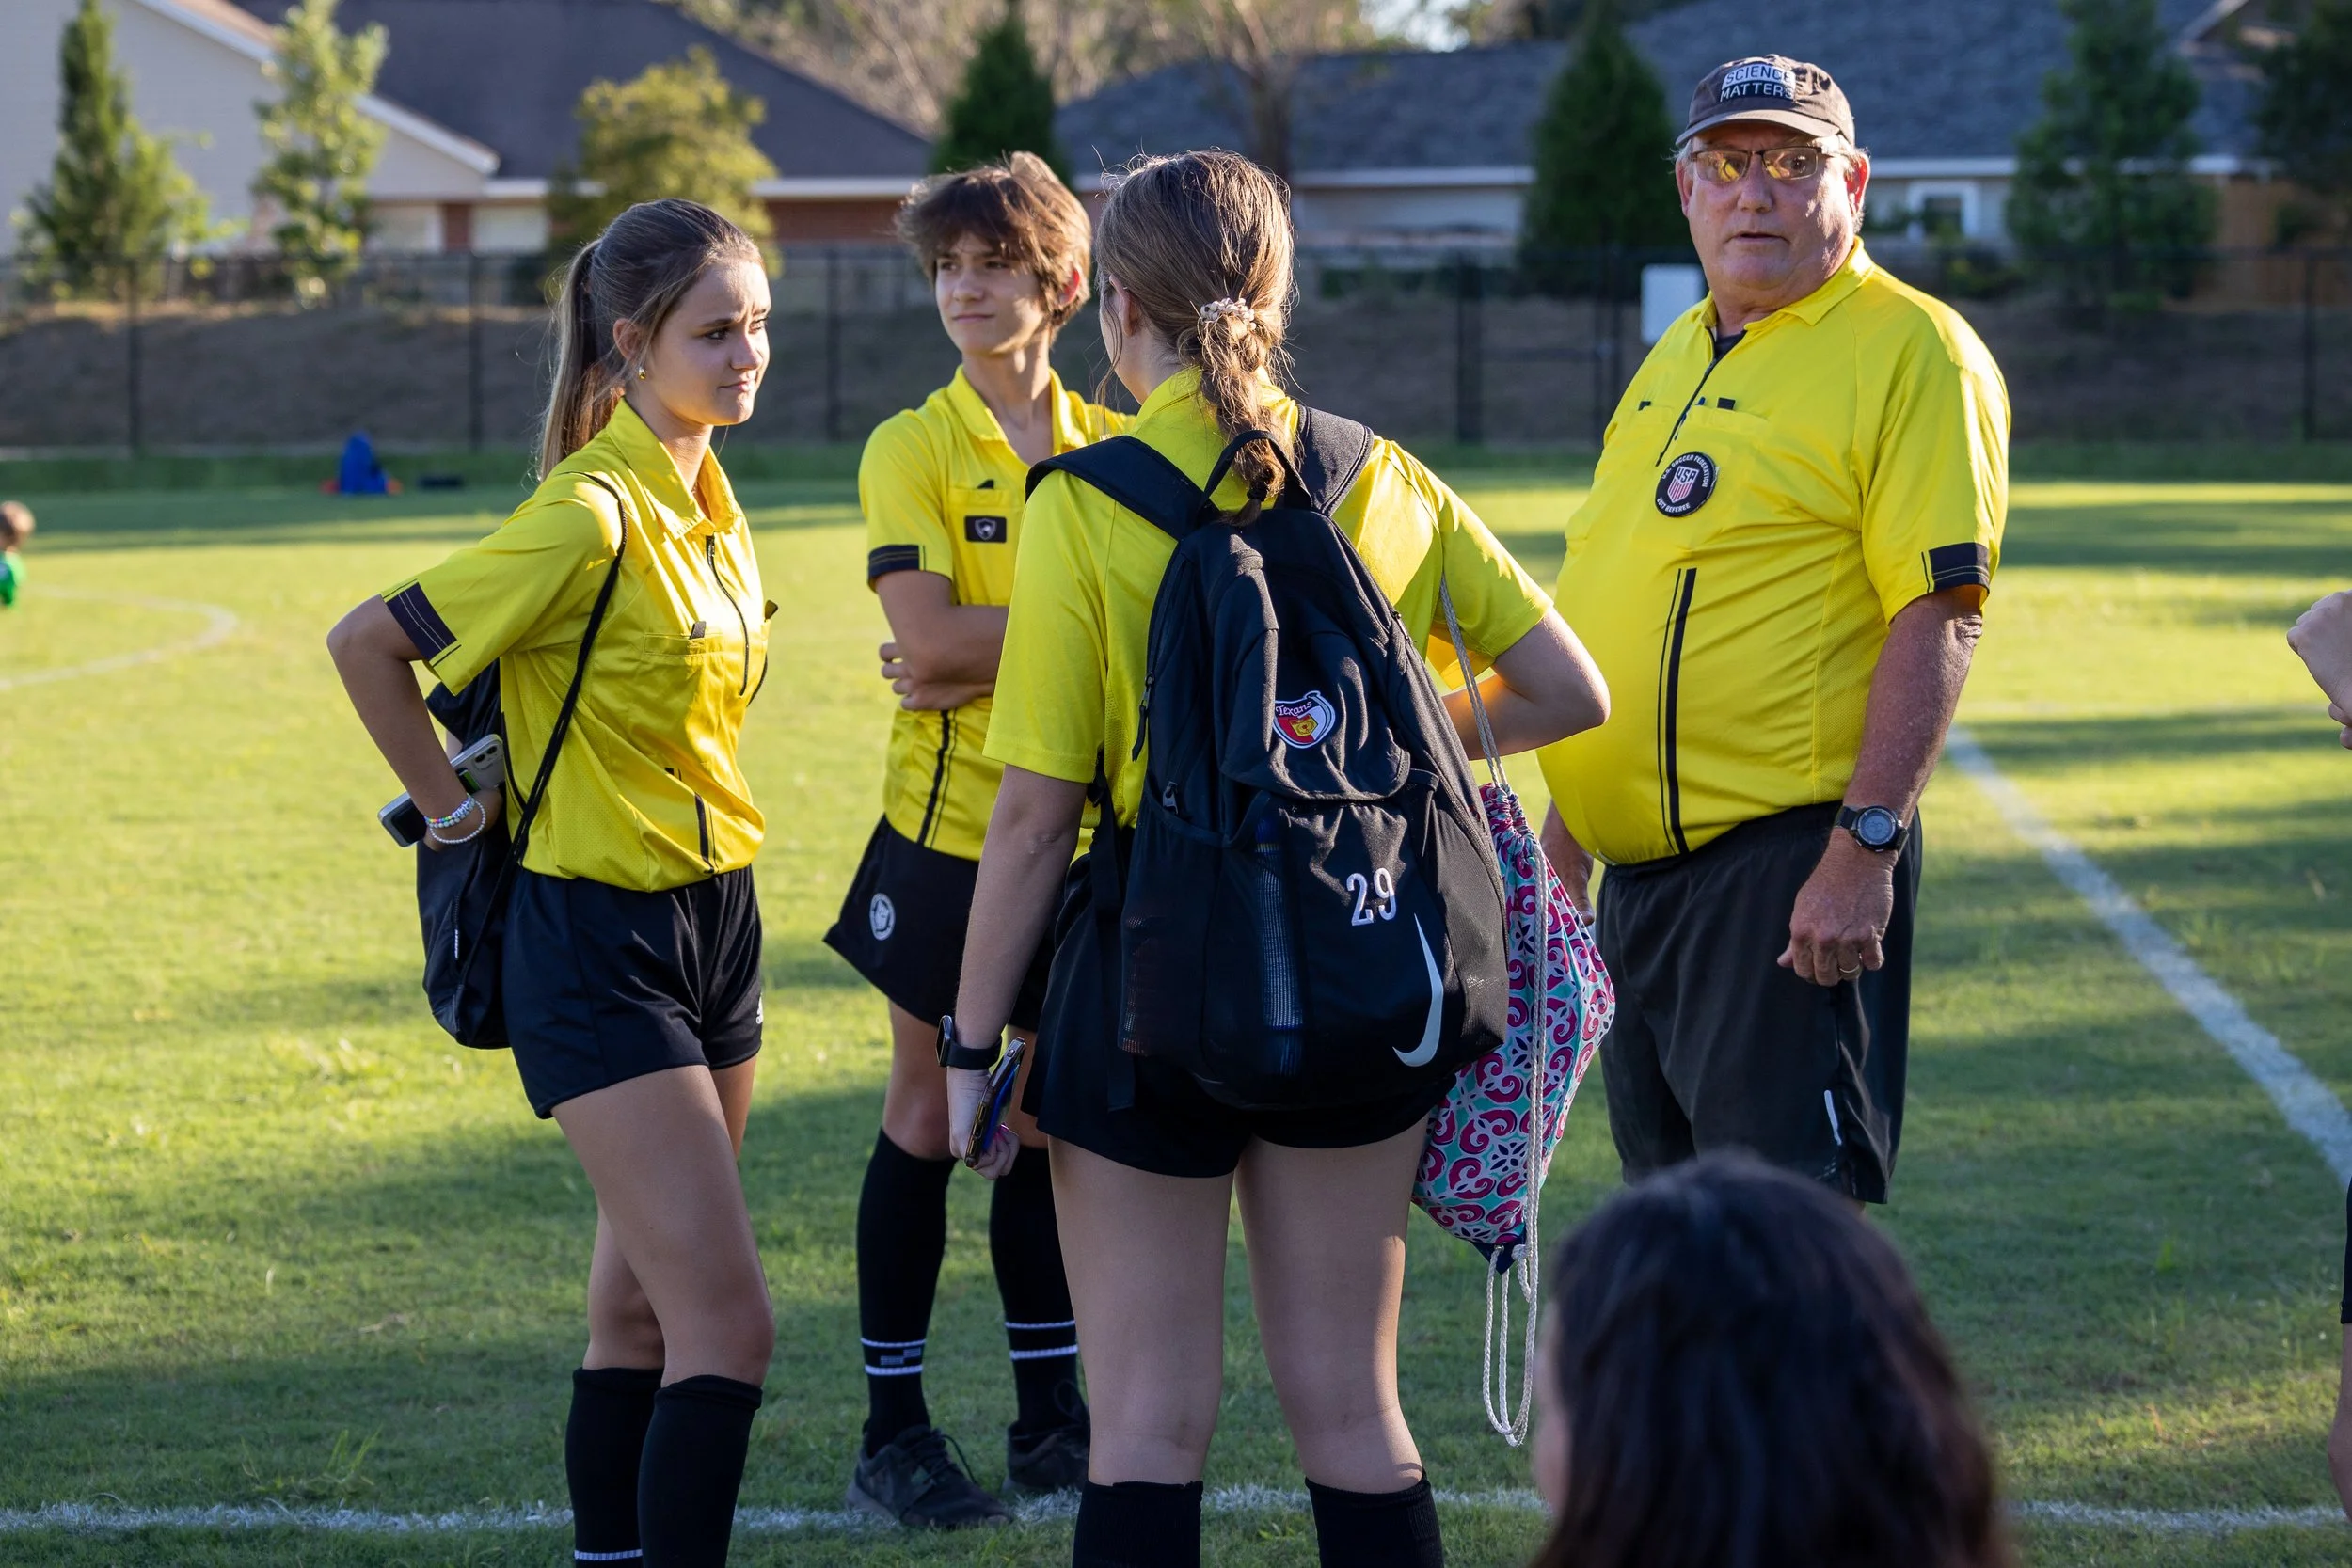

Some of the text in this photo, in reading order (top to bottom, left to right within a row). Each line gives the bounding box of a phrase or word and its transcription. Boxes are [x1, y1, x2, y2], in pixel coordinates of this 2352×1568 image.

[1725, 65, 1791, 85] SCIENCE
[1720, 81, 1793, 103] MATTERS
[1671, 454, 1694, 467] SOCCER
[1693, 455, 1710, 488] FEDERATION
[1676, 467, 1697, 483] USA
[1664, 502, 1691, 513] REFEREE
[1275, 701, 1312, 717] Texans
[1346, 867, 1397, 927] 29
